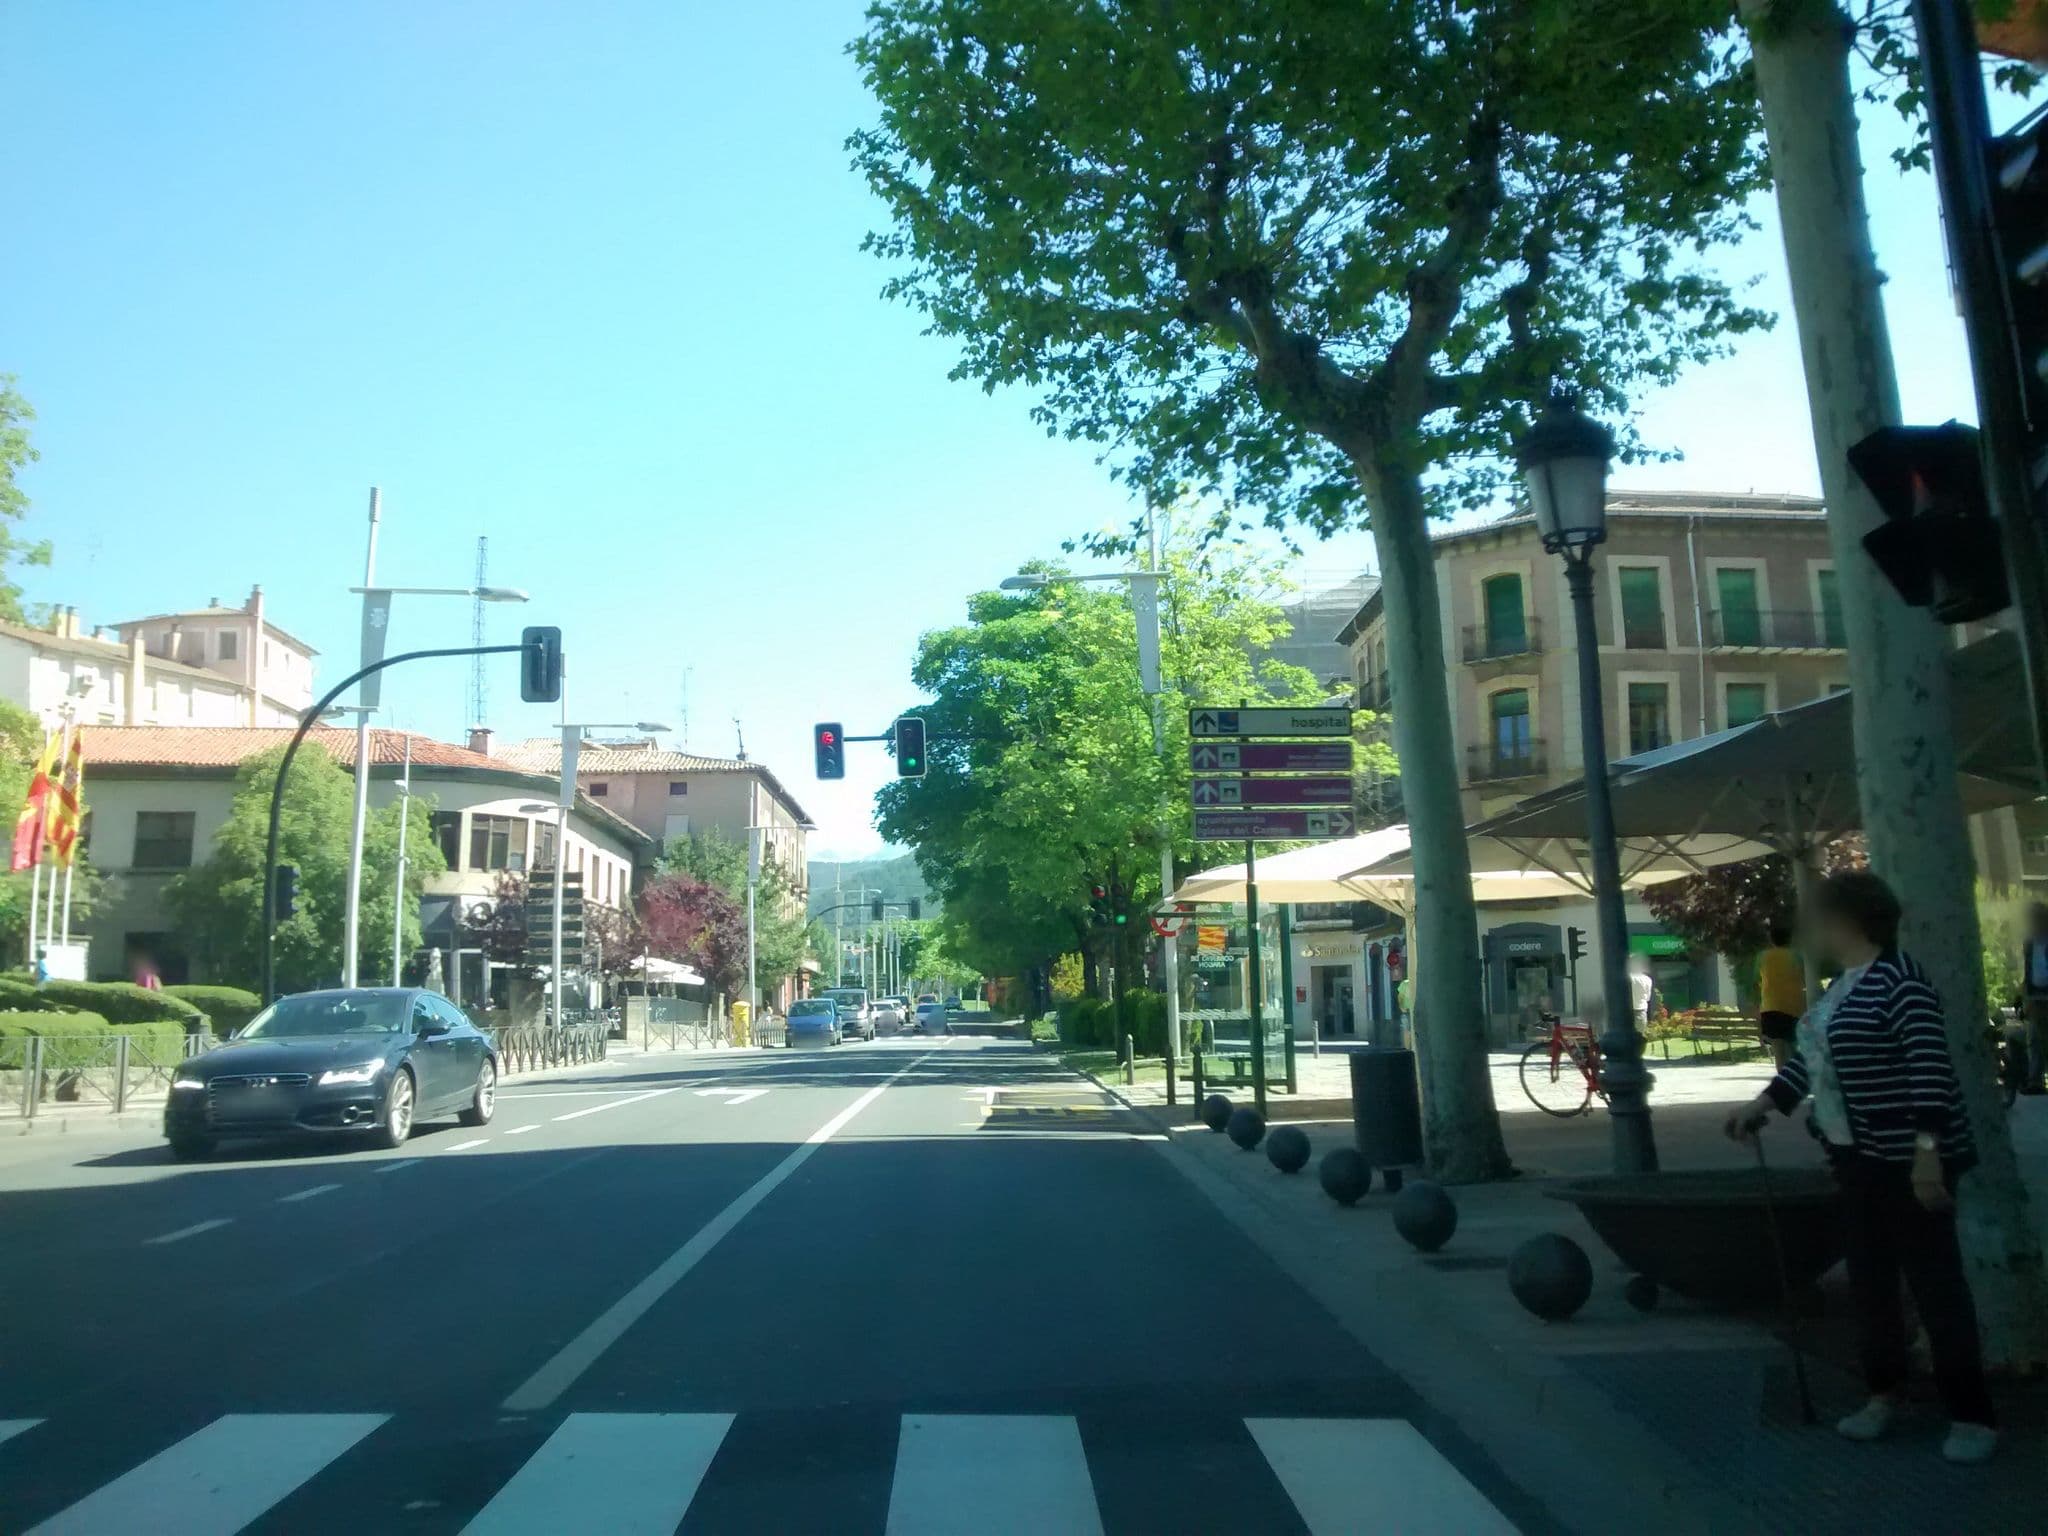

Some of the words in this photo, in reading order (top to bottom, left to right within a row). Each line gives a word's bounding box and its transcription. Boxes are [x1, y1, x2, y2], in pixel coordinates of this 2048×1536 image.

[1291, 716, 1347, 729] hospital
[1314, 944, 1360, 958] Santander
[1509, 941, 1541, 951] codere
